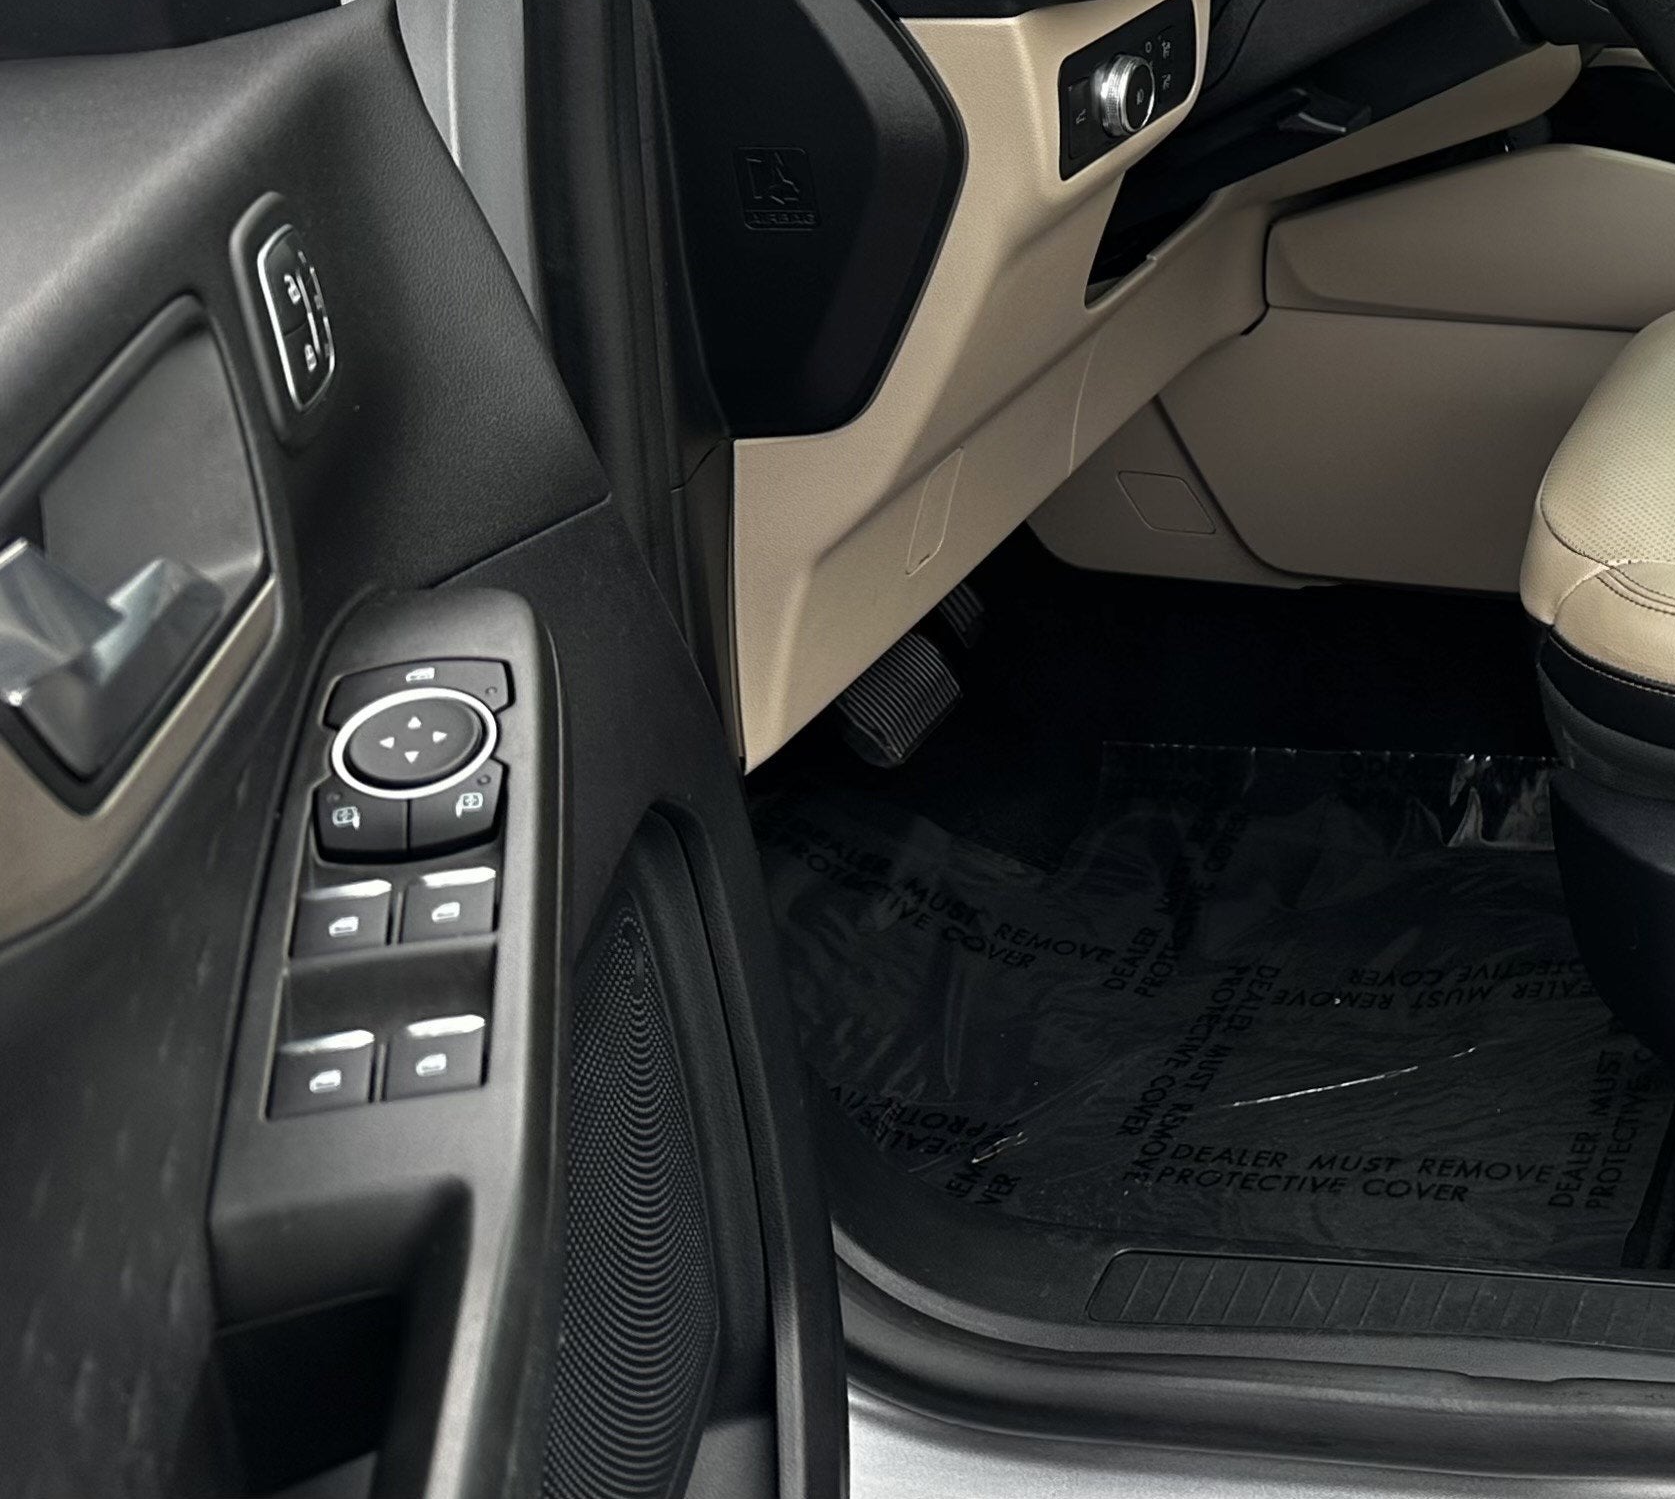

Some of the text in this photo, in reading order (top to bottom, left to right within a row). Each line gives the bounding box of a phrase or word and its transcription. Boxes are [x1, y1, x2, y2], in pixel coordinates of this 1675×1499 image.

[902, 877, 984, 926] MUST
[993, 922, 1116, 965] REMOVE
[942, 923, 1038, 969] COVER
[1103, 926, 1162, 992] DEALER
[1347, 959, 1583, 986] OTECTIVE COVER
[1271, 979, 1590, 1010] EALER MUST REMOVE
[1115, 967, 1251, 1135] PROTECTIVE COVER
[1122, 966, 1279, 1180] DEALER MUST REMOVE
[1547, 1048, 1622, 1207] DEALER MUST
[1585, 1074, 1652, 1210] PROTECTIVE
[1153, 1165, 1469, 1203] PROTECTIVE COVER
[1170, 1142, 1556, 1184] DEALER MUST REMOVE
